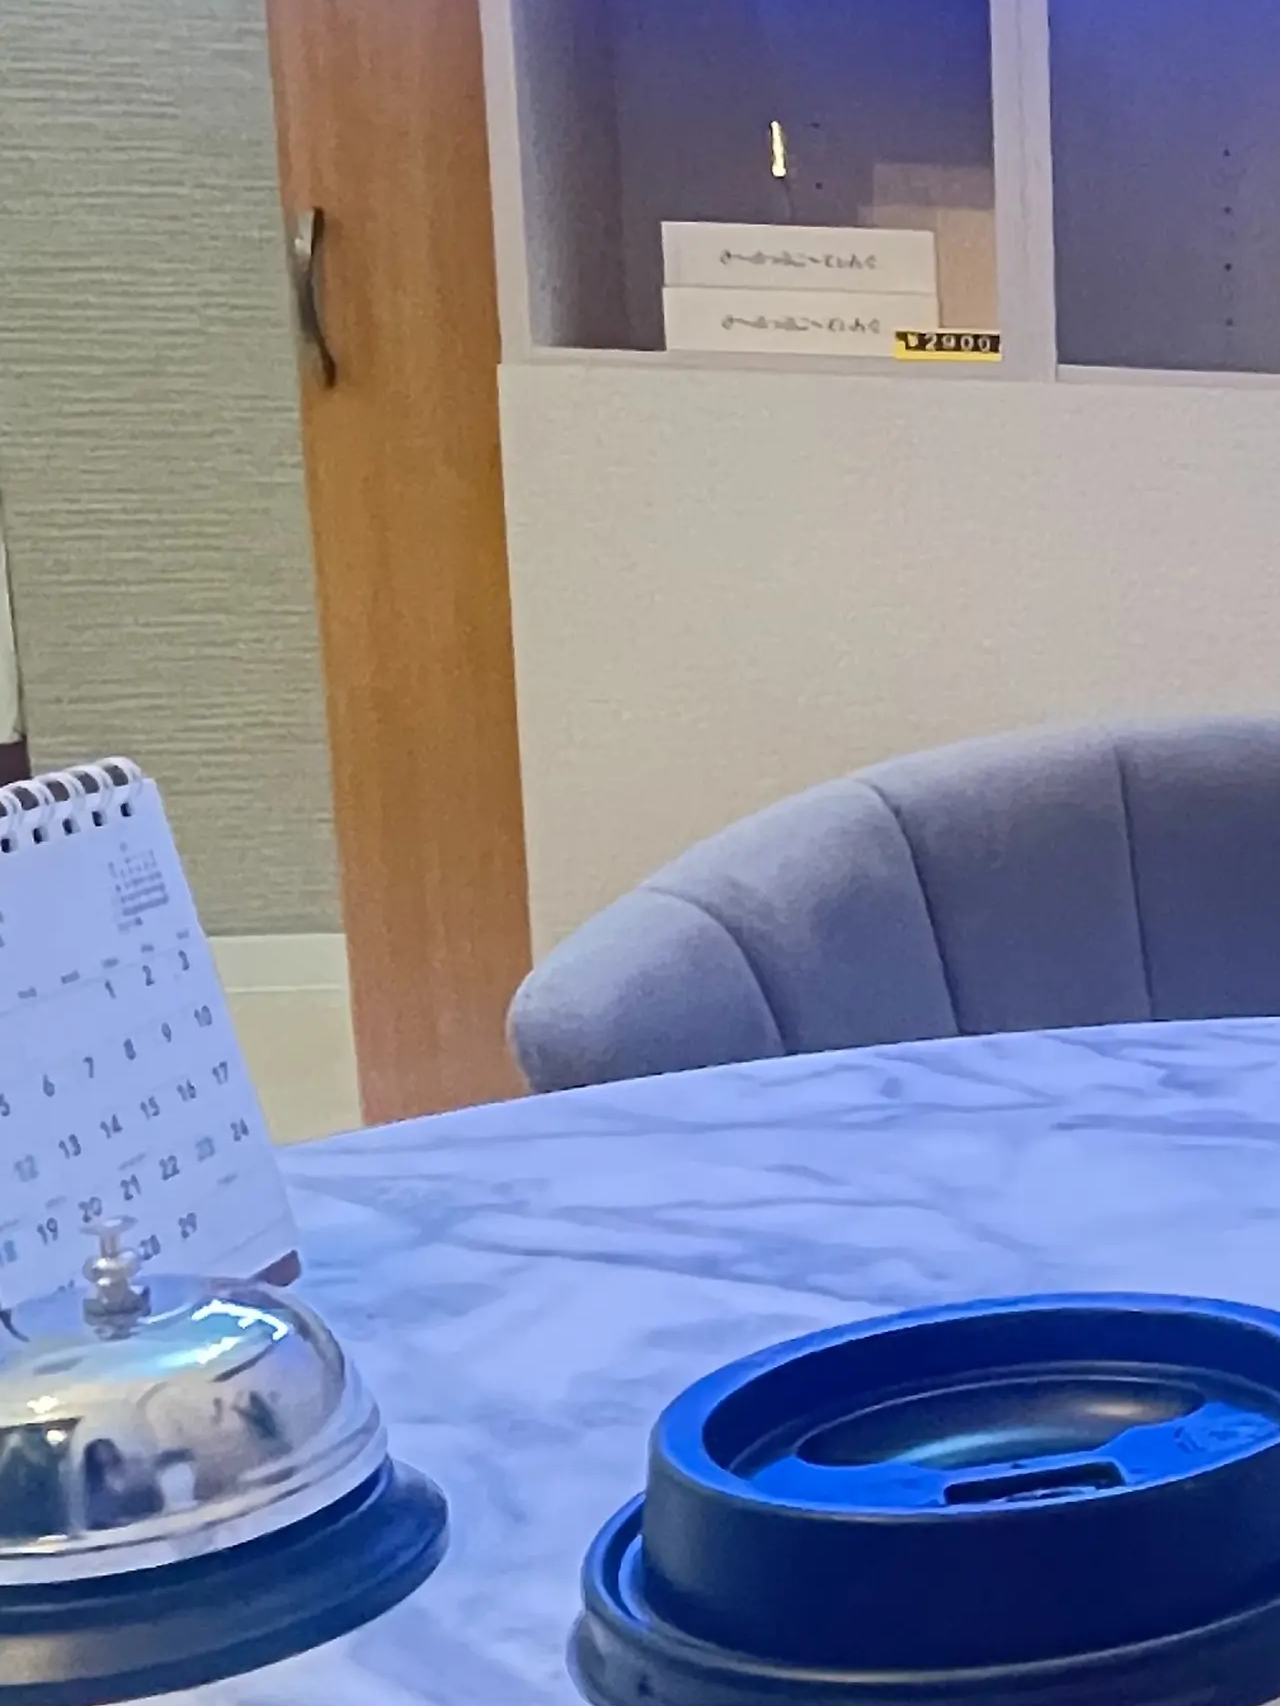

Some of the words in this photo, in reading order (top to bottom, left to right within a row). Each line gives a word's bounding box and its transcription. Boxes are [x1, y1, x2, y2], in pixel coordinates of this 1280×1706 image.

[58, 1134, 82, 1160] 13
[100, 1114, 123, 1139] 14
[140, 1096, 160, 1121] 15
[213, 1061, 228, 1085] 17
[83, 1056, 94, 1078] 7
[37, 1217, 58, 1246] 19
[78, 1196, 102, 1224] 20
[120, 1174, 141, 1200] 21
[159, 1155, 180, 1181] 22
